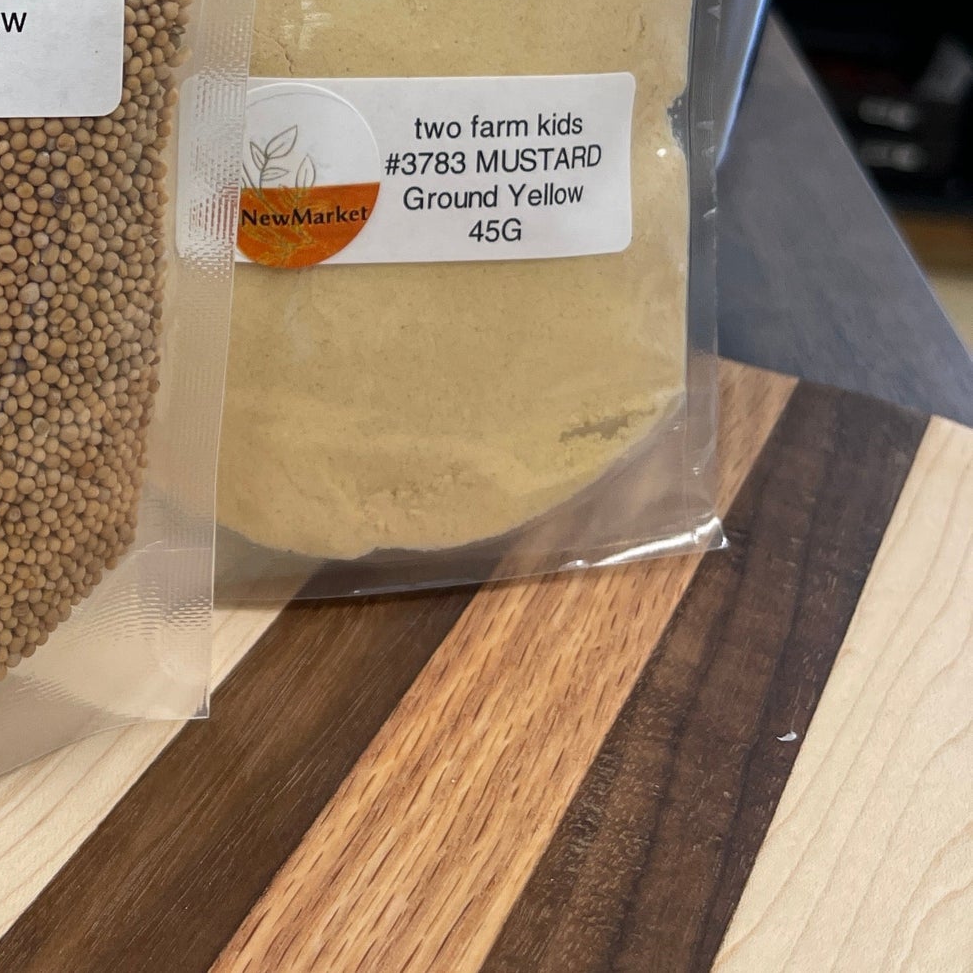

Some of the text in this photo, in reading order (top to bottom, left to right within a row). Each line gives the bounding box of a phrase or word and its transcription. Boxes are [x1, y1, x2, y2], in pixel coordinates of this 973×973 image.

[414, 112, 583, 139] two farm kids
[385, 144, 602, 176] #3783 MUSTARD
[403, 182, 584, 210] Ground Yellow
[241, 205, 368, 227] NewMarket
[468, 218, 522, 242] 45G
